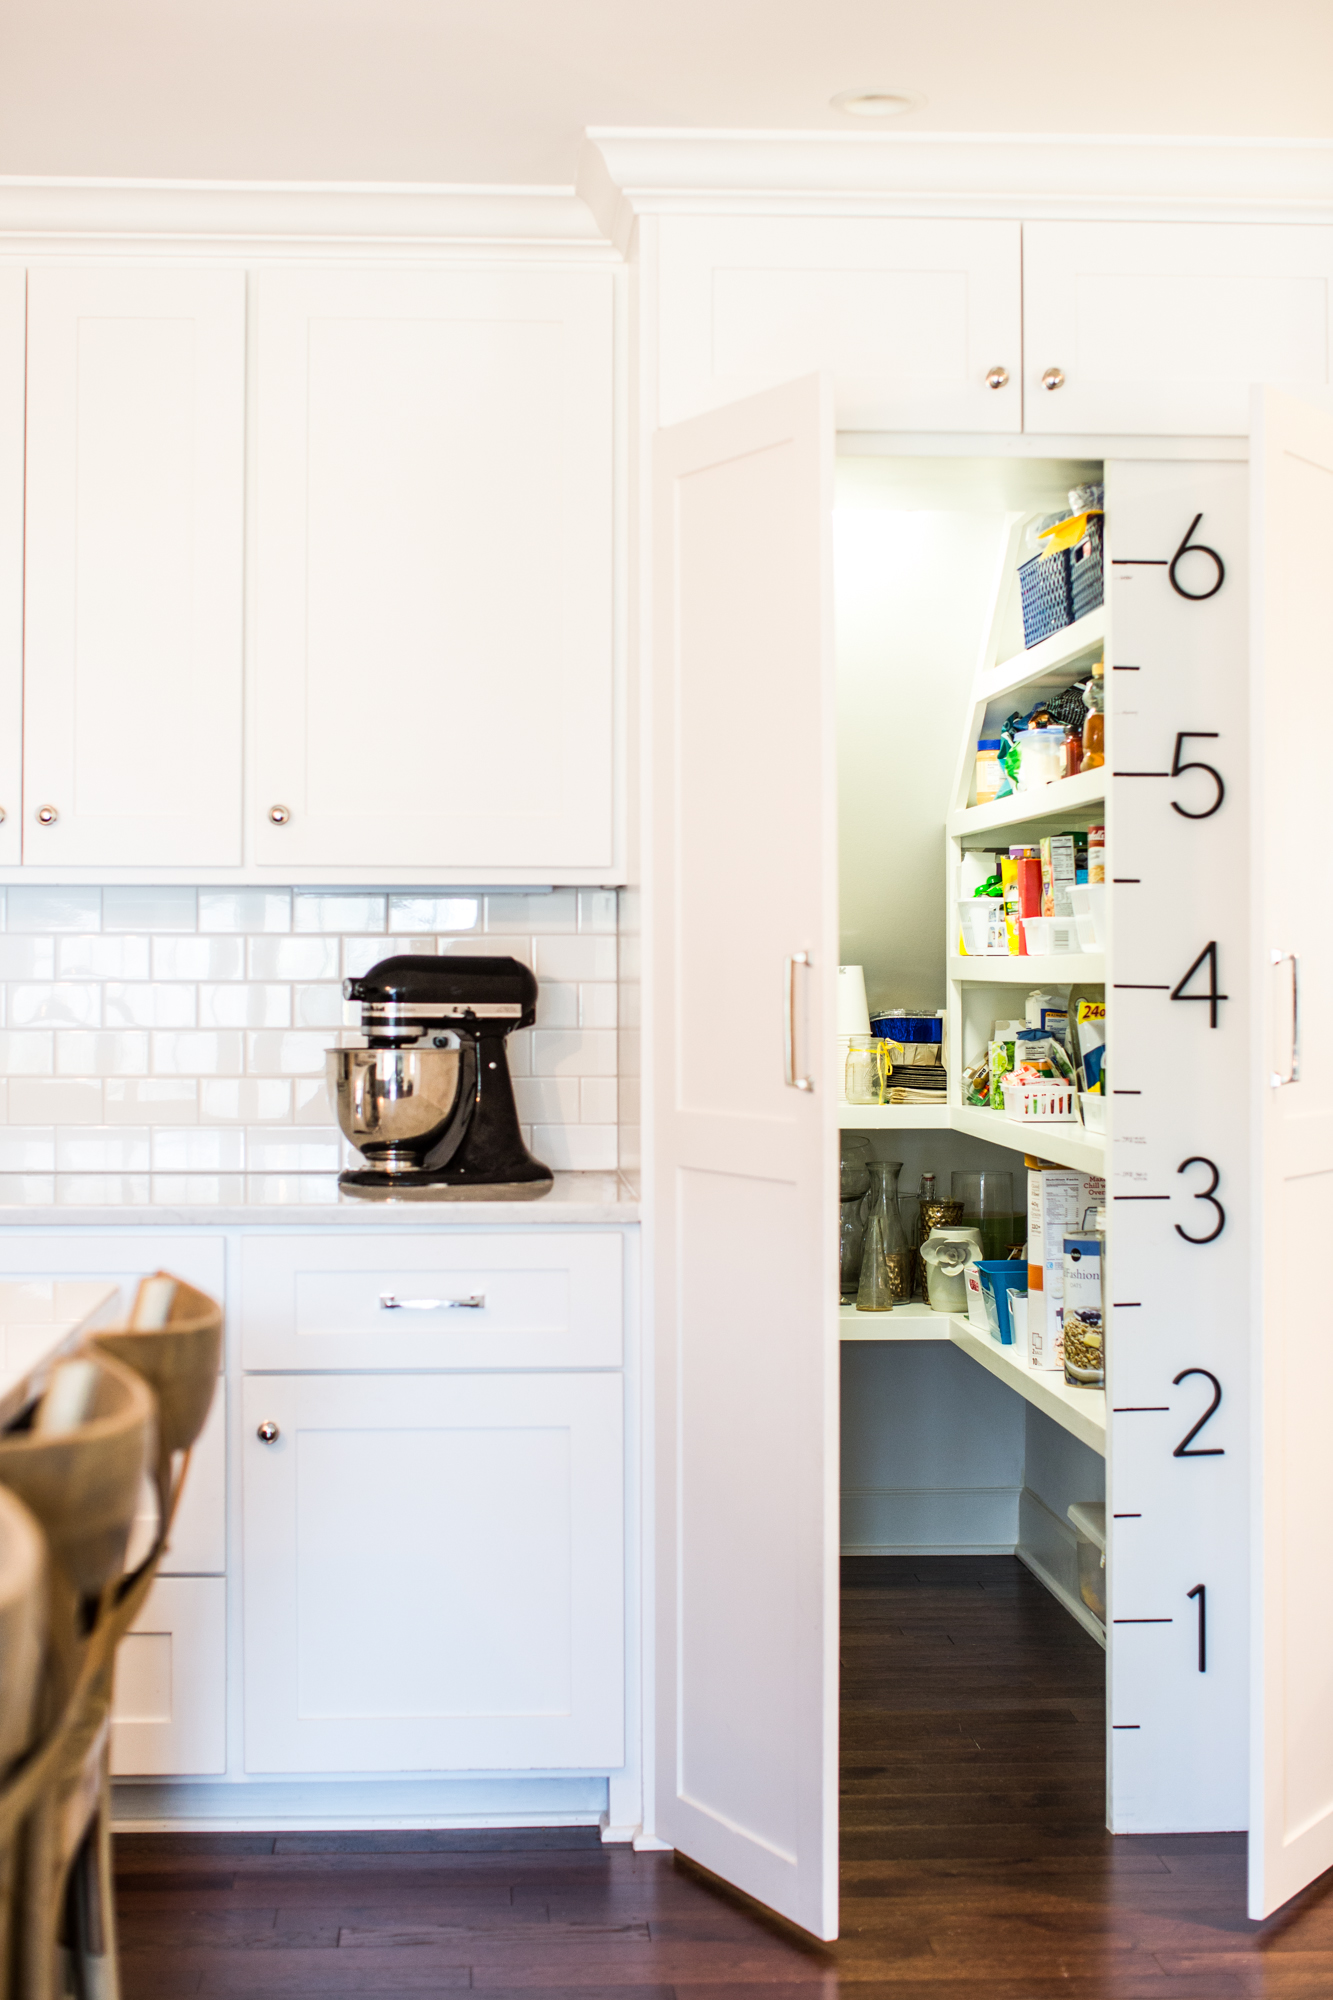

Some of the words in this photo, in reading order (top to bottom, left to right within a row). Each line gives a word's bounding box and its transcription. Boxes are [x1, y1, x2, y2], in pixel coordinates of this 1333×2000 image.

[1169, 512, 1226, 601] 6
[1170, 731, 1226, 820] 5
[1170, 940, 1229, 1029] 4
[1174, 1156, 1226, 1245] 3
[1172, 1367, 1225, 1458] 2
[1186, 1583, 1207, 1673] 1
